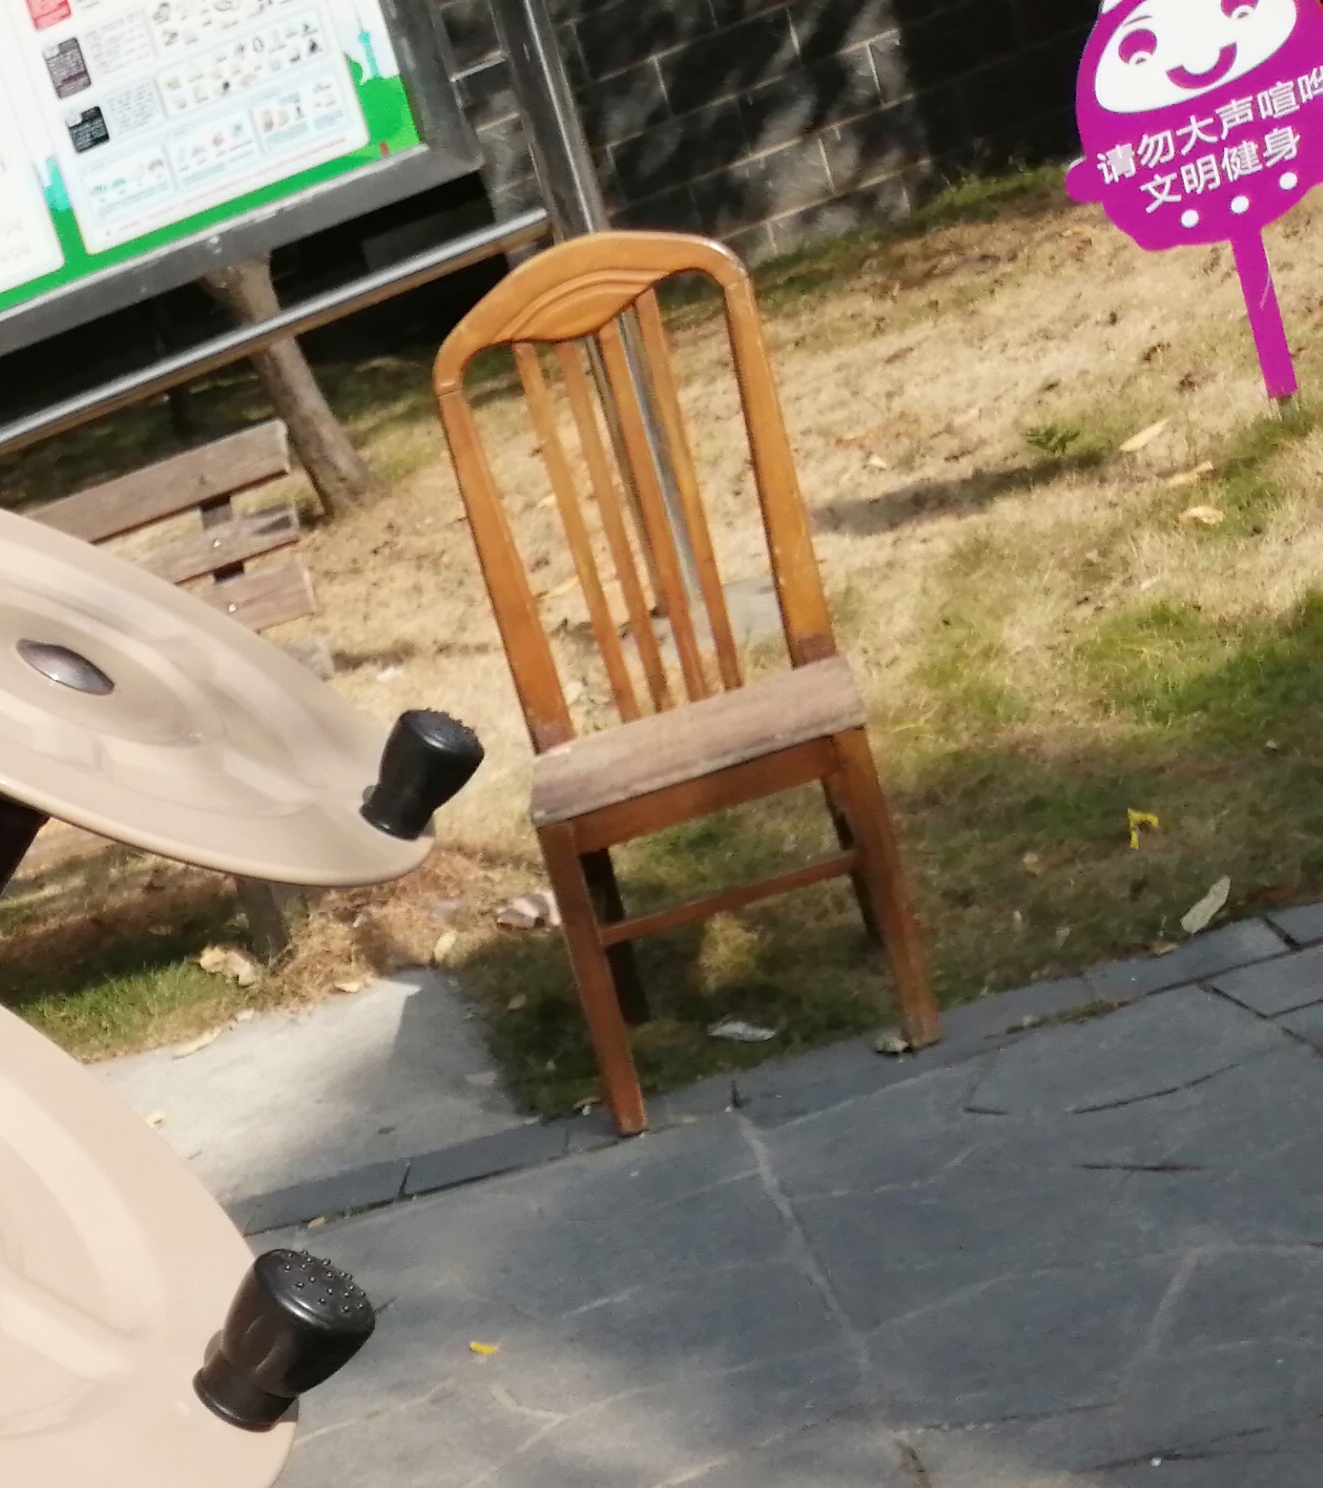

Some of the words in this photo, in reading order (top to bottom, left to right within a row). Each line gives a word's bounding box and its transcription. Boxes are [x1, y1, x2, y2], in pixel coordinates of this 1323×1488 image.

[1097, 65, 1323, 184] 请勿大声喧哗
[1140, 126, 1301, 213] 文明健身
